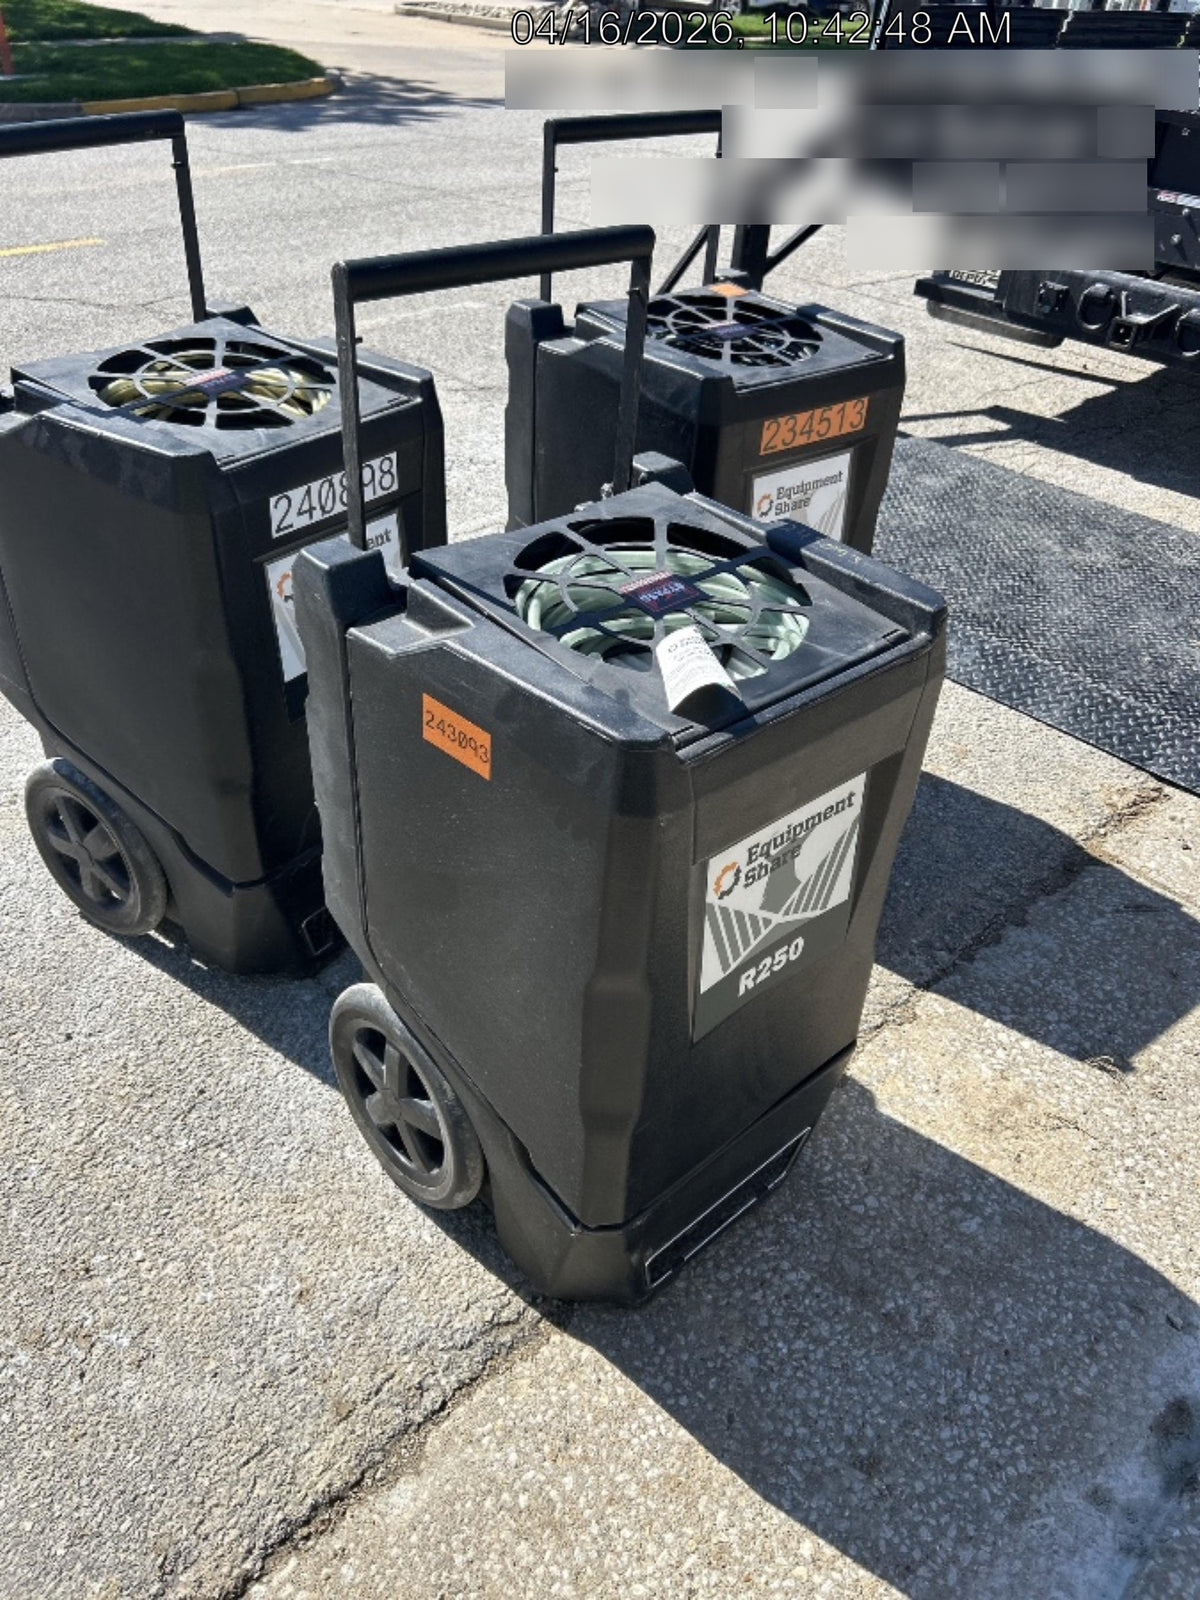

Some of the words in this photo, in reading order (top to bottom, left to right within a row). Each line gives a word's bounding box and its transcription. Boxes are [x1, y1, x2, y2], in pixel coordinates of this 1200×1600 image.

[762, 400, 865, 452] 234513
[774, 496, 812, 517] Share
[775, 470, 844, 502] Equipment
[425, 709, 490, 764] 243093
[746, 790, 857, 866] Equipment
[743, 844, 802, 890] Share
[737, 936, 805, 999] R250
